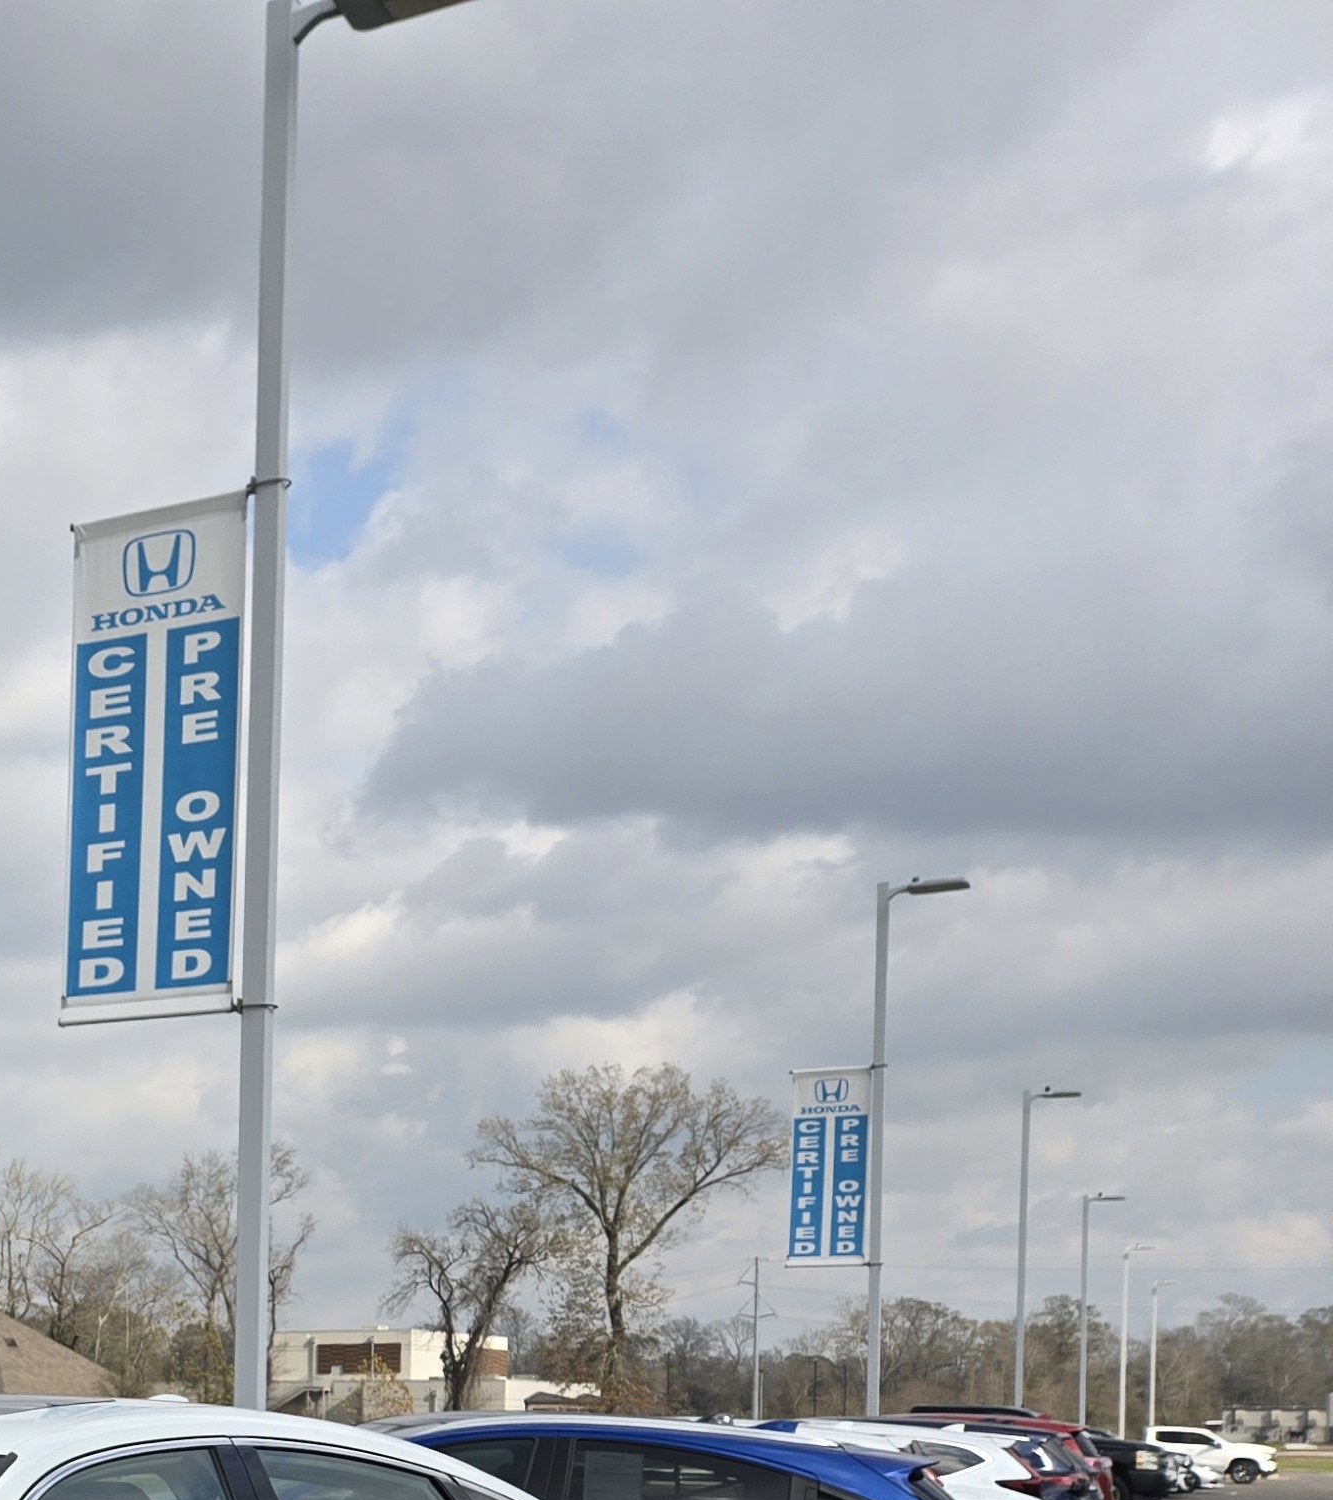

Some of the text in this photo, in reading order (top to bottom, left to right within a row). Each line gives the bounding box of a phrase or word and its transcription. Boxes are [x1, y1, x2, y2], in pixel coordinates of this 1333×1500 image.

[90, 593, 226, 632] HONDA
[78, 645, 136, 989] CERTIFIED
[167, 629, 227, 982] PRE OWNED
[800, 1104, 862, 1115] HONDA
[794, 1120, 821, 1255] CERTIFIED
[835, 1118, 862, 1254] PRE OWNED
